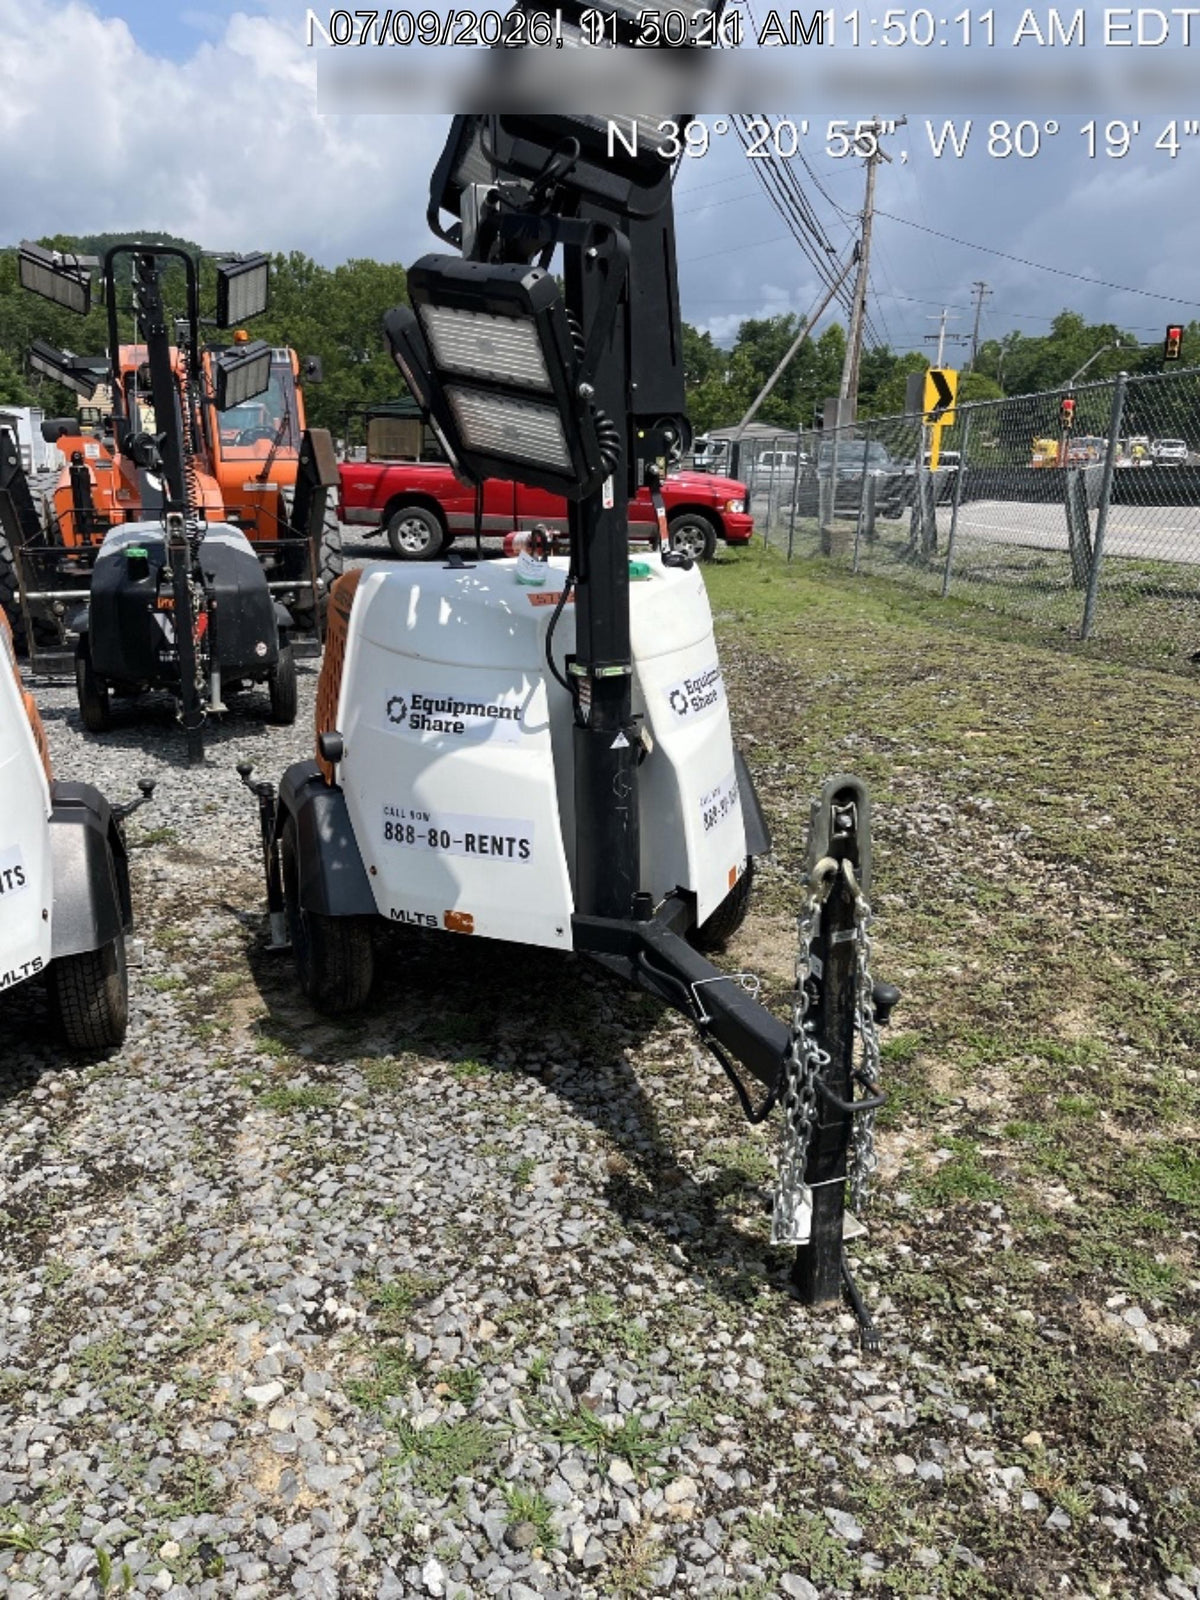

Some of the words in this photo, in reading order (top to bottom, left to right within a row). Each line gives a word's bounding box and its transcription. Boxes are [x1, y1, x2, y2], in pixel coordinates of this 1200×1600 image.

[410, 694, 522, 721] Equipment
[408, 713, 465, 735] Share
[383, 806, 406, 819] CALL
[383, 820, 531, 860] 888-80-RENTS
[389, 907, 439, 927] MLTS
